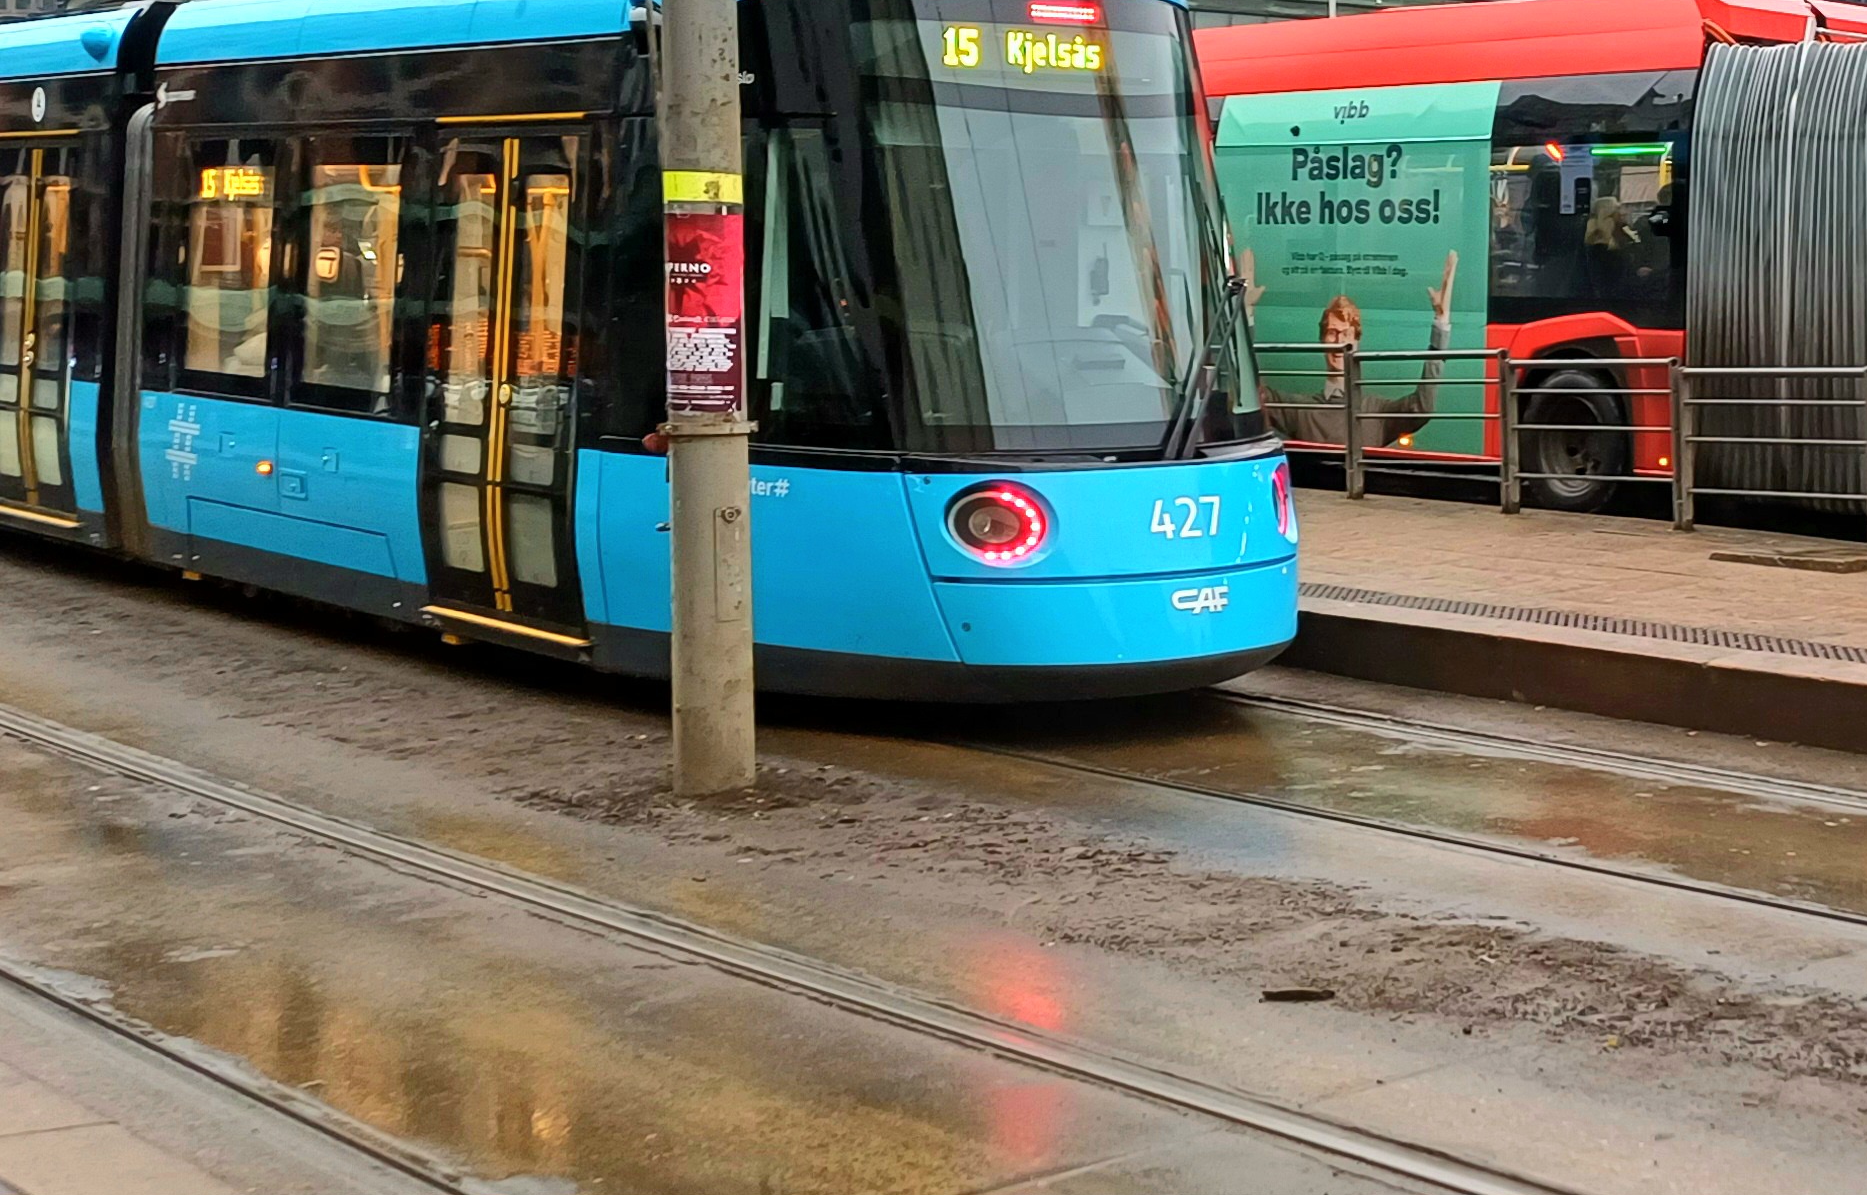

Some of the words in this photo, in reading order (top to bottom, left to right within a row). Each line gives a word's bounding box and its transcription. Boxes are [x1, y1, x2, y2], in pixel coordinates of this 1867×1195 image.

[942, 26, 980, 68] 15
[1006, 30, 1101, 74] Kjelsås
[1292, 144, 1403, 189] Påslag?
[1256, 191, 1312, 225] Ikke
[1318, 190, 1371, 225] hos
[1378, 189, 1440, 225] oss!
[749, 476, 791, 498] ter#
[1150, 495, 1221, 540] 427
[1171, 585, 1229, 615] CAF
